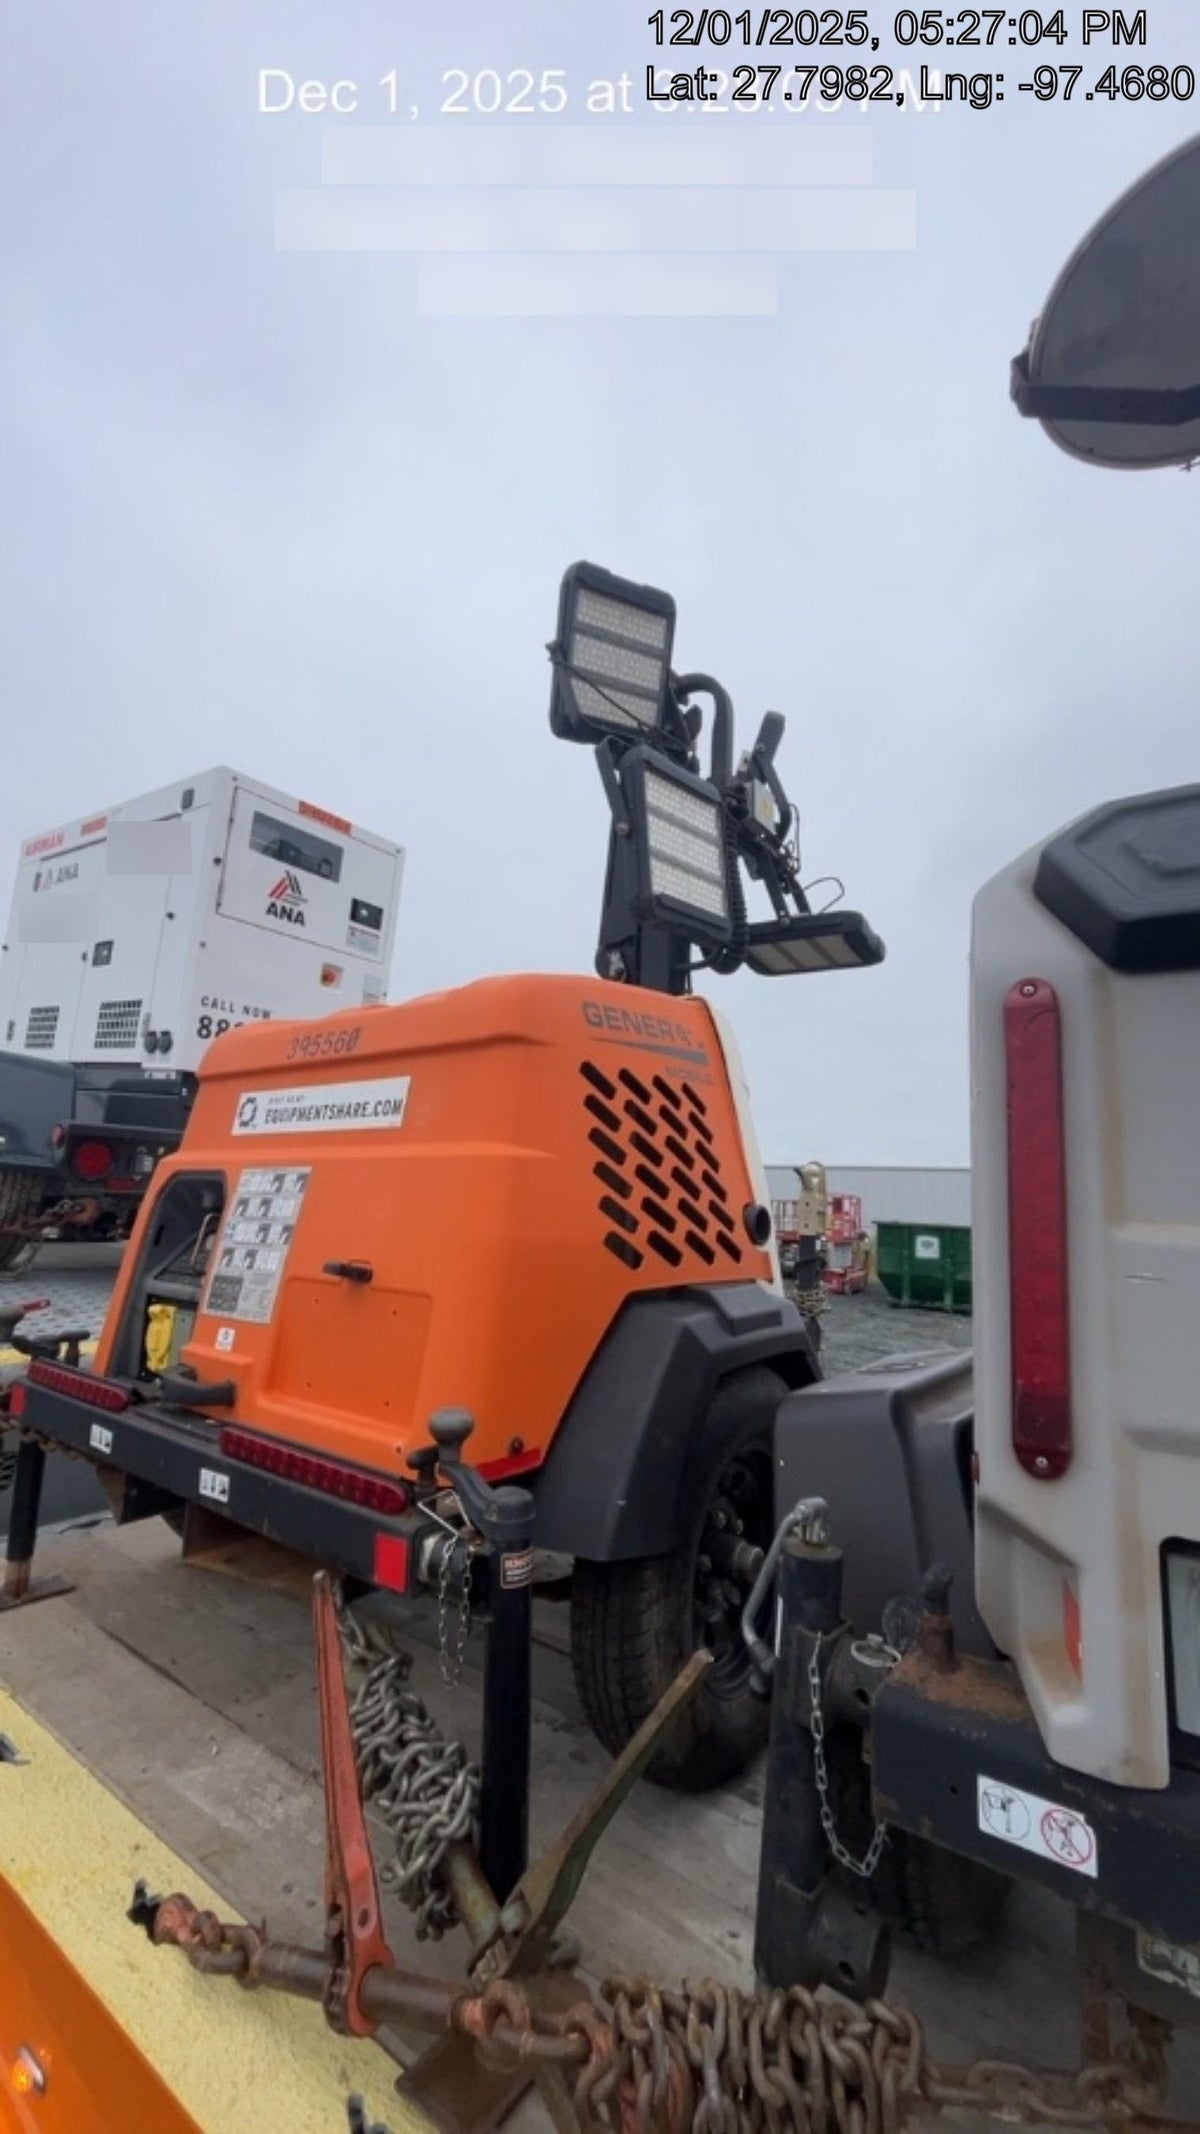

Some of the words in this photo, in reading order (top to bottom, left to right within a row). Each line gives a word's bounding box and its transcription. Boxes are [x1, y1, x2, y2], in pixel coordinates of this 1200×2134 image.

[266, 902, 306, 927] ANA
[201, 995, 236, 1013] CALL
[242, 1004, 272, 1020] NOW
[197, 1015, 244, 1040] 88
[265, 1098, 403, 1125] EQUIPMENTSHARE.COM
